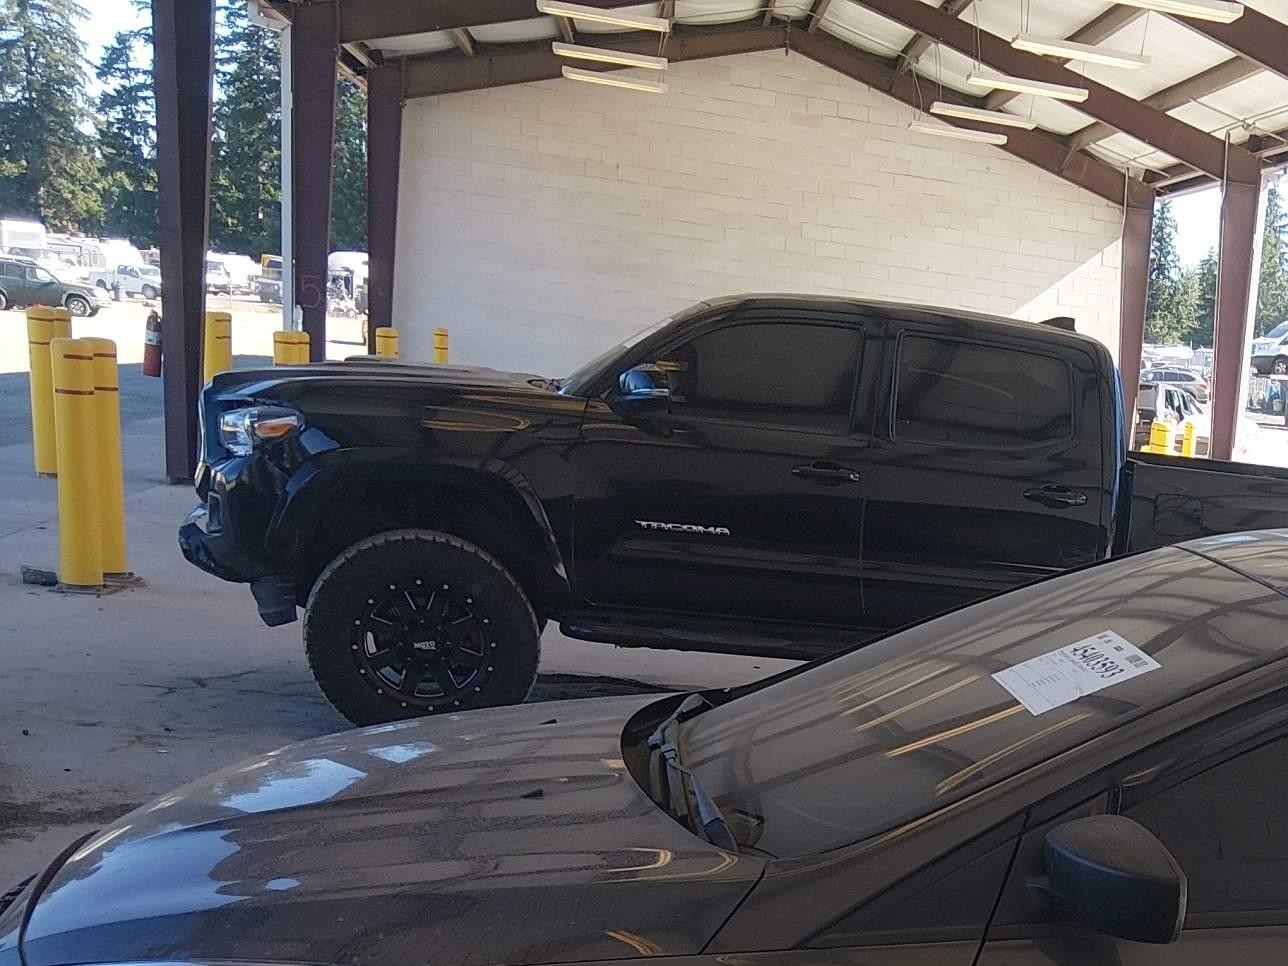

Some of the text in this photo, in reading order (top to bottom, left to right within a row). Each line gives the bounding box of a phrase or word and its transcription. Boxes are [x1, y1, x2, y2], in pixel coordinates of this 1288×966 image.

[301, 274, 322, 309] 5
[634, 519, 731, 537] TACOMA
[1070, 644, 1126, 679] 45403593
